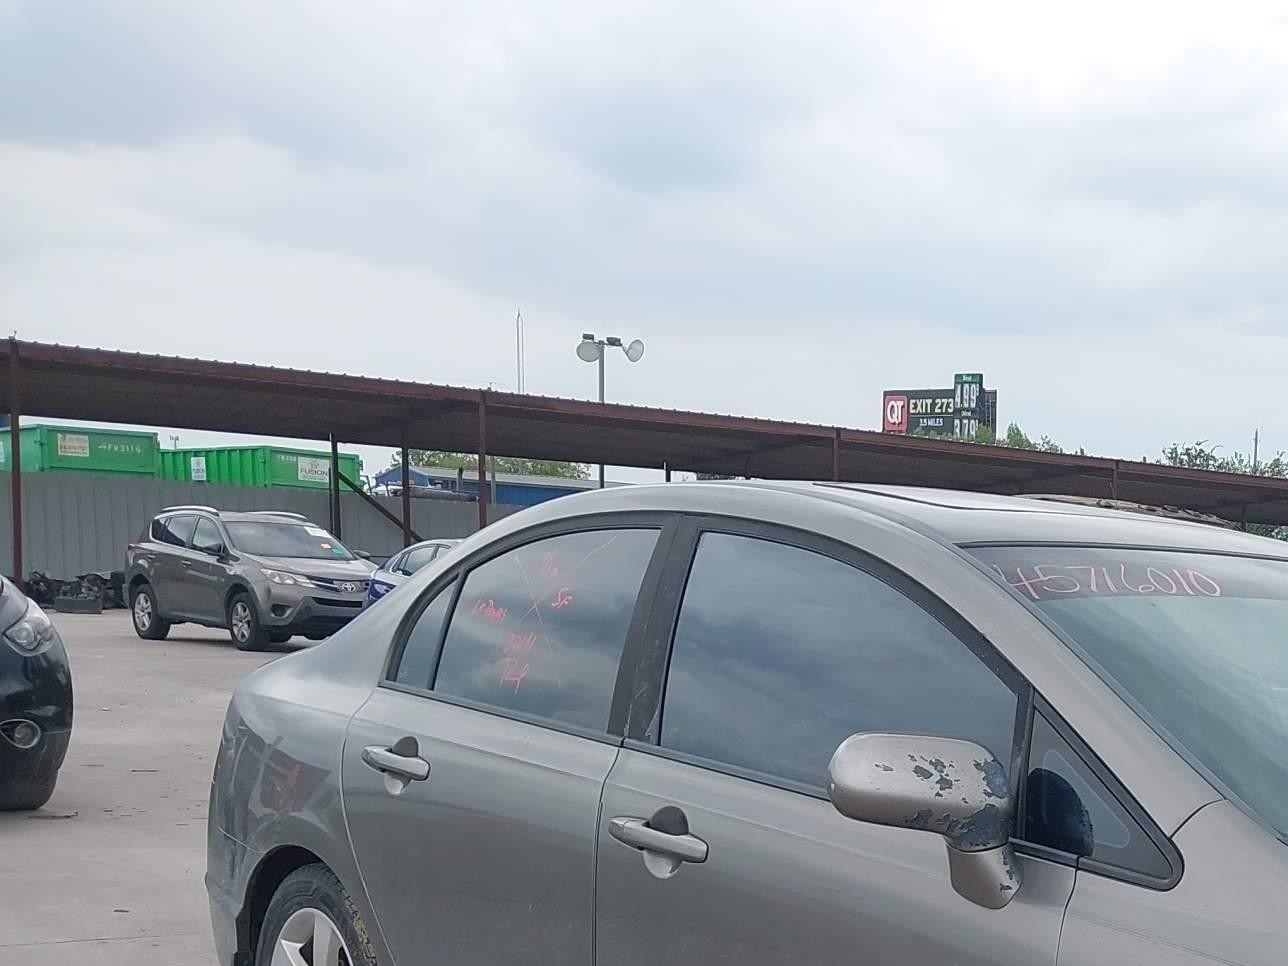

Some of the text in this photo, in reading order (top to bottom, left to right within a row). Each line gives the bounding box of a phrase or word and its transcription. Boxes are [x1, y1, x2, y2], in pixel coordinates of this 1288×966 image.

[887, 400, 904, 426] QT
[910, 398, 954, 413] EXIT 273
[993, 563, 1221, 598] 45716010
